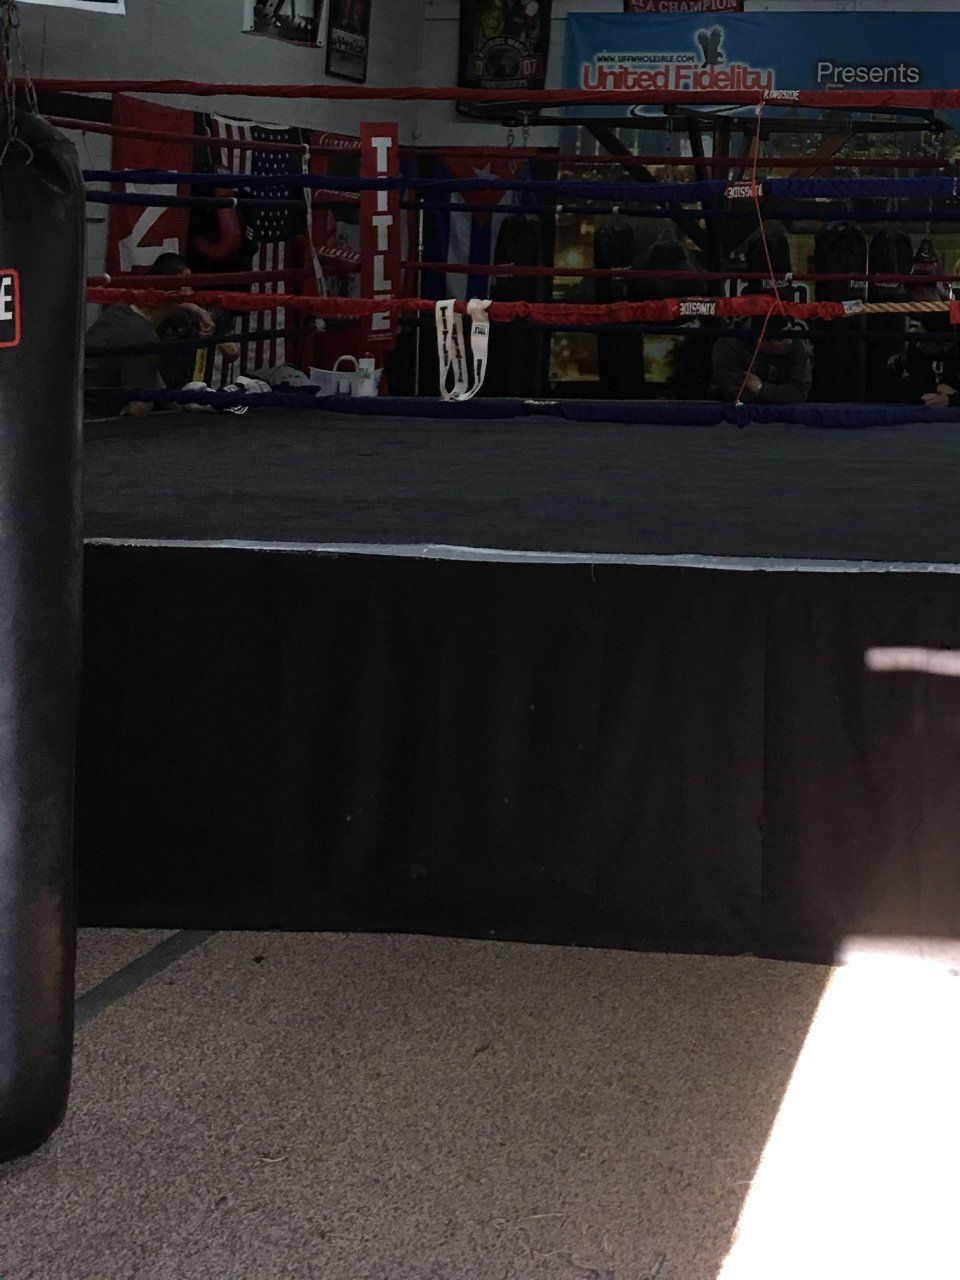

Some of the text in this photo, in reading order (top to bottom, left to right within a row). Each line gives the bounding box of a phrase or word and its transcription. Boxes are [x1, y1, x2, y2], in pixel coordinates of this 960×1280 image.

[582, 63, 774, 92] United Fidelity
[816, 61, 920, 84] Presents
[762, 89, 800, 101] RINGSIDE
[371, 136, 394, 331] TITLE
[679, 302, 716, 316] RINGSIDE
